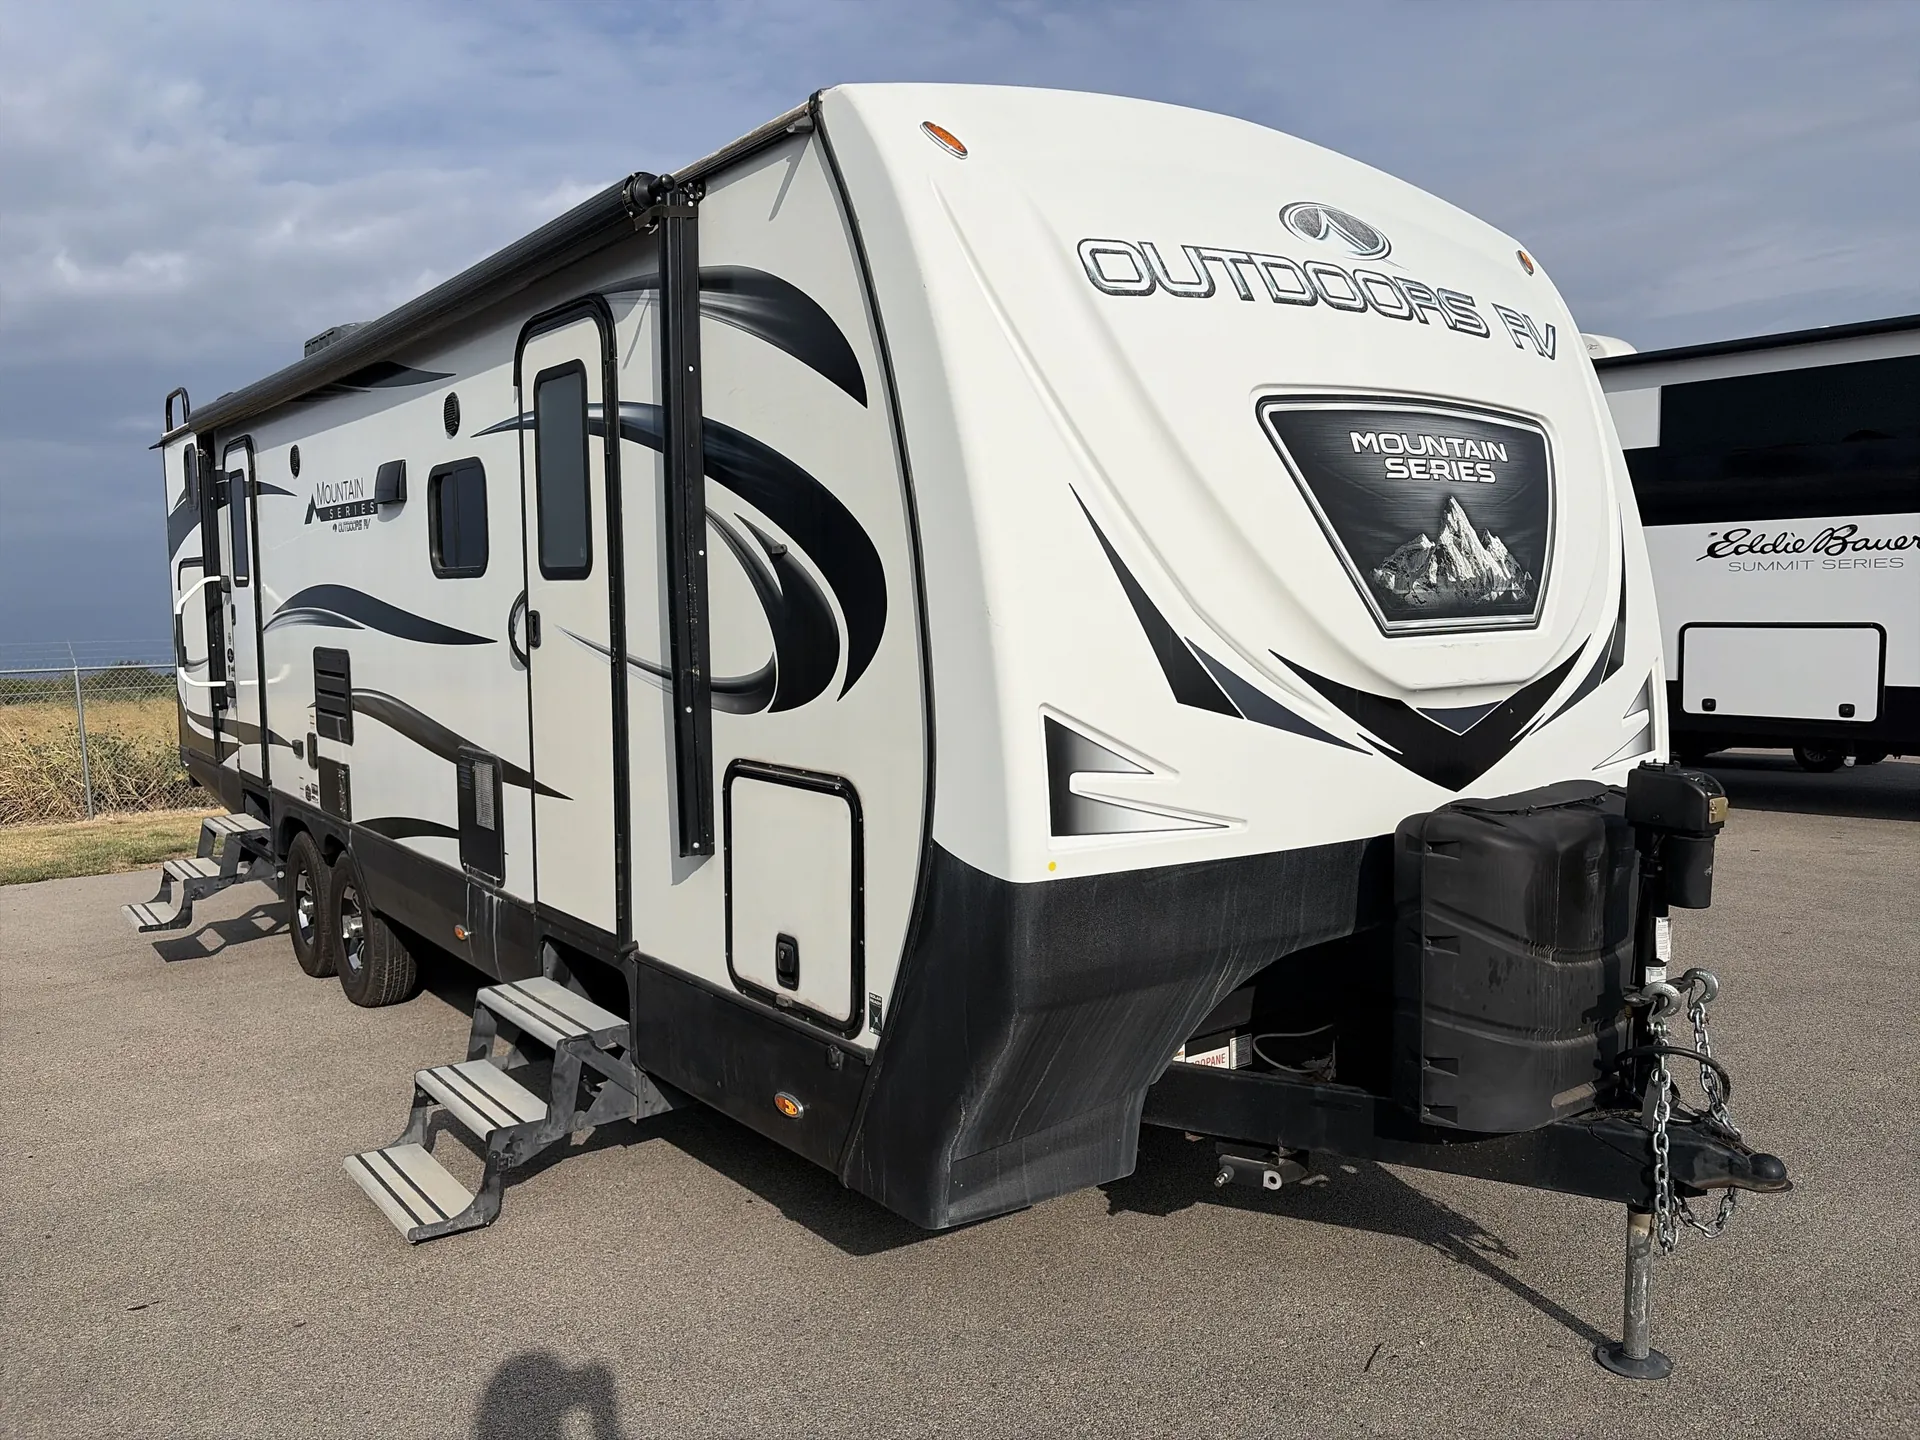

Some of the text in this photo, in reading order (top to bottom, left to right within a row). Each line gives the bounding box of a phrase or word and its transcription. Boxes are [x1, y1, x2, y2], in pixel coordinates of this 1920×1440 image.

[1077, 238, 1557, 360] OUTDOORS RV
[1349, 431, 1509, 463] MOUNTAIN
[1384, 457, 1496, 484] SERIES
[316, 477, 364, 506] MOUNTAIN
[329, 501, 375, 519] SERIES
[1696, 527, 1806, 561] Eddie
[1728, 557, 1905, 572] SUMMIT SERIES
[1192, 1053, 1226, 1066] ROPANE
